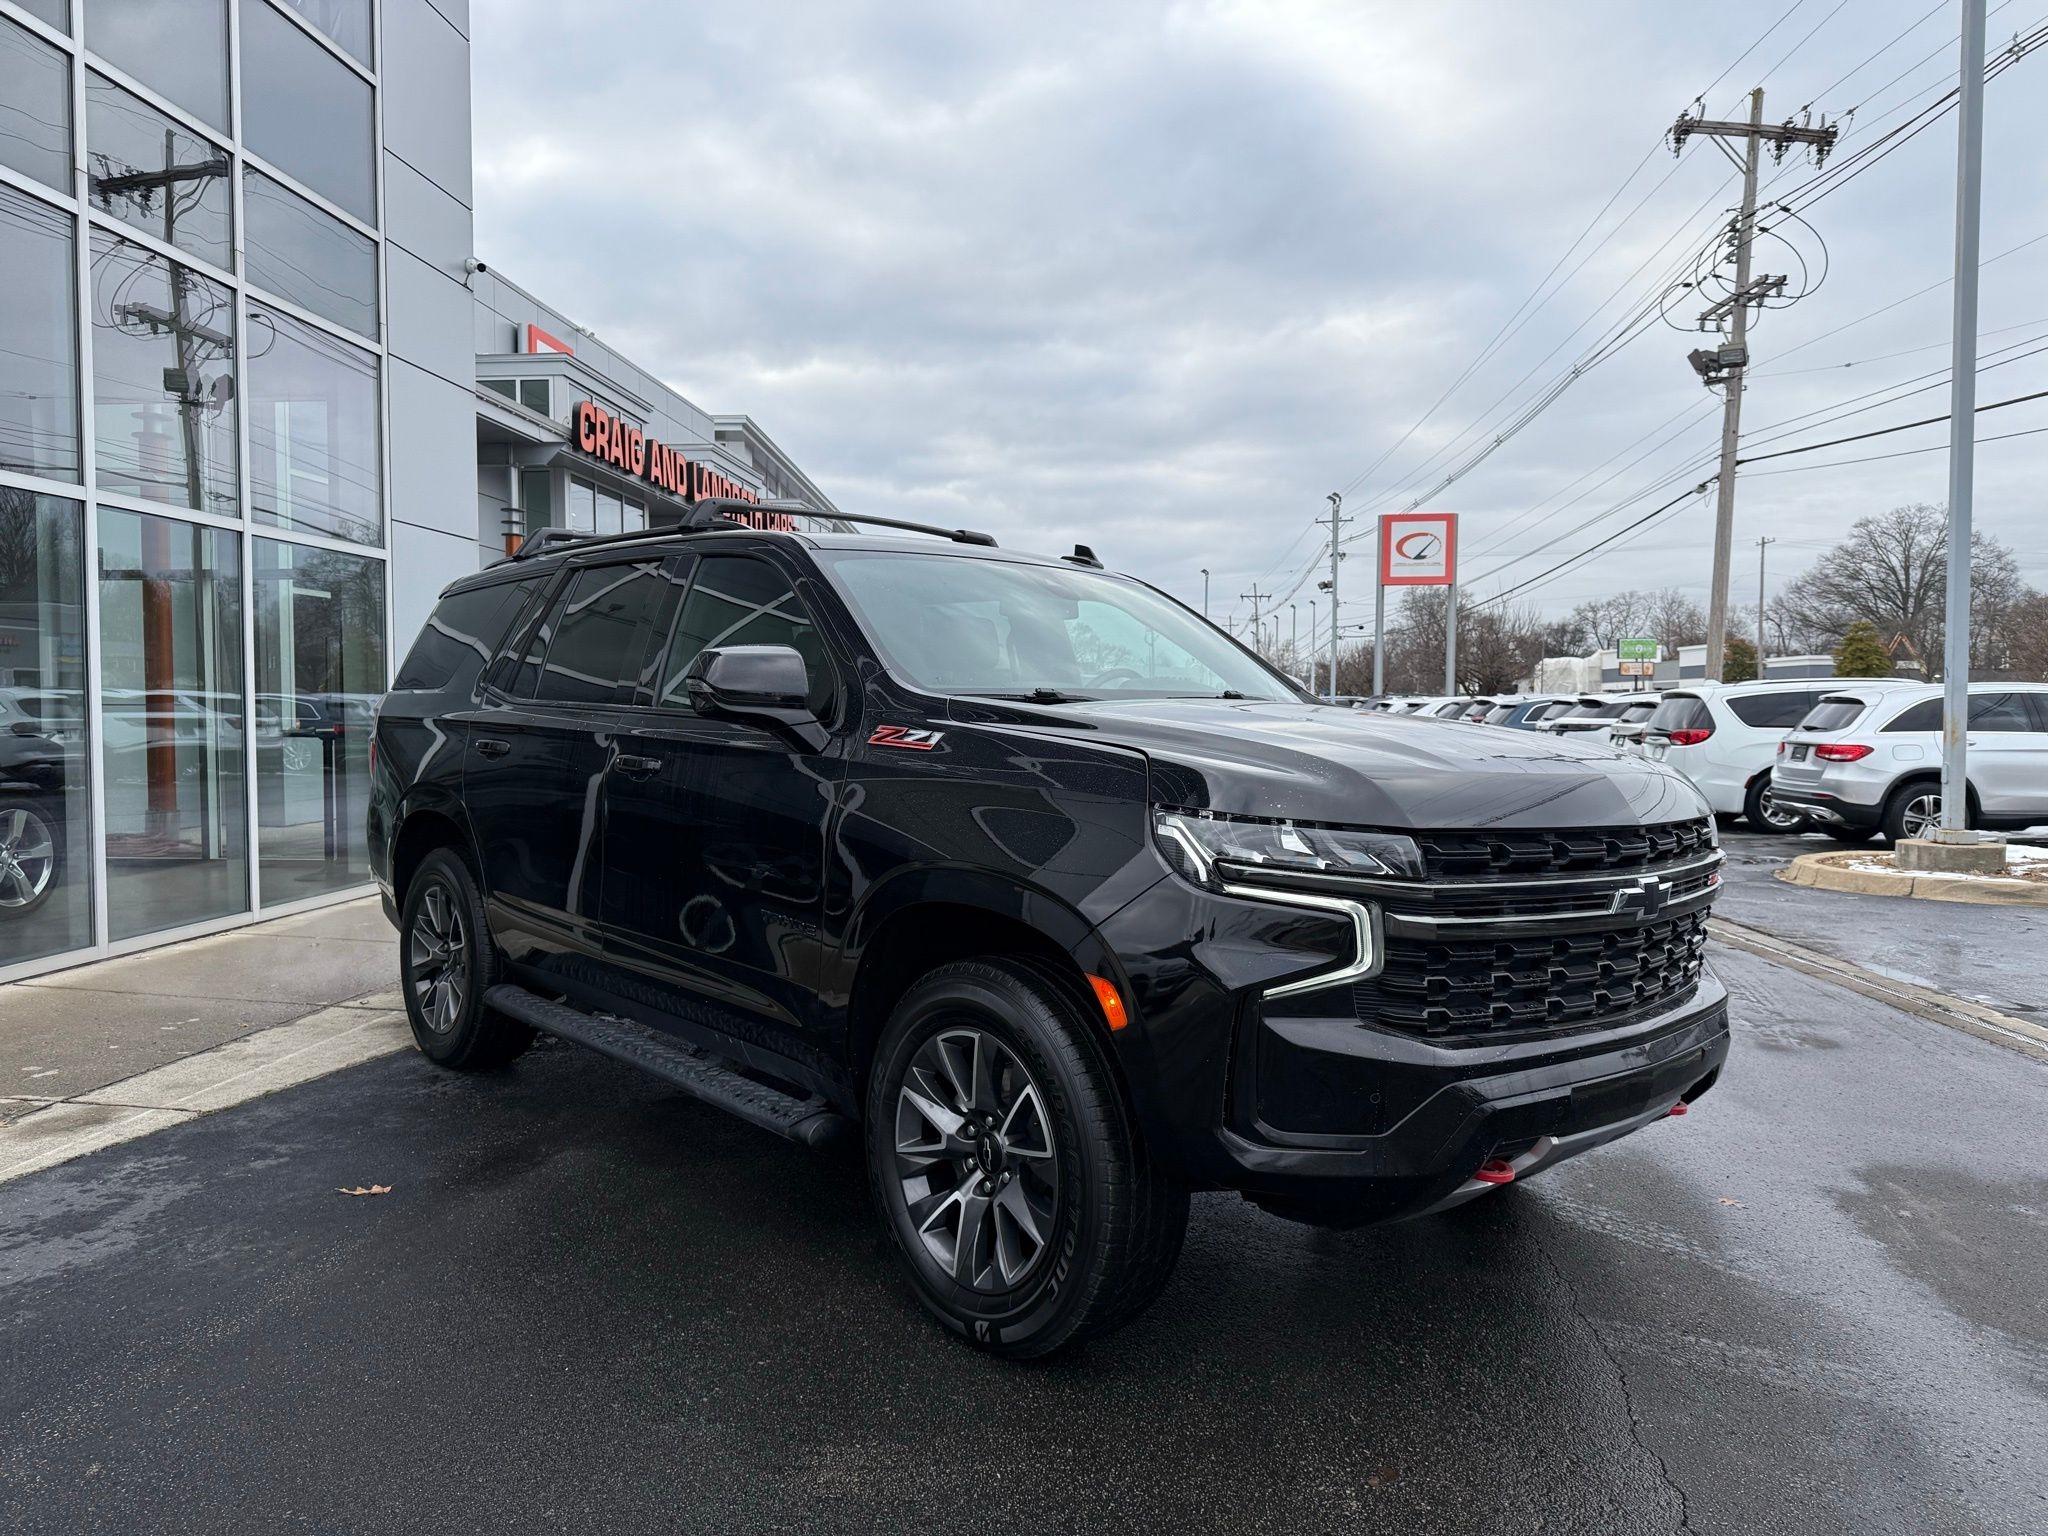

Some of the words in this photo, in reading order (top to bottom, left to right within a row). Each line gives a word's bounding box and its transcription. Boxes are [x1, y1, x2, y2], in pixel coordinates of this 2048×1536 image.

[579, 401, 644, 477] CRAIG
[650, 439, 687, 497] AND
[867, 725, 946, 750] Z71
